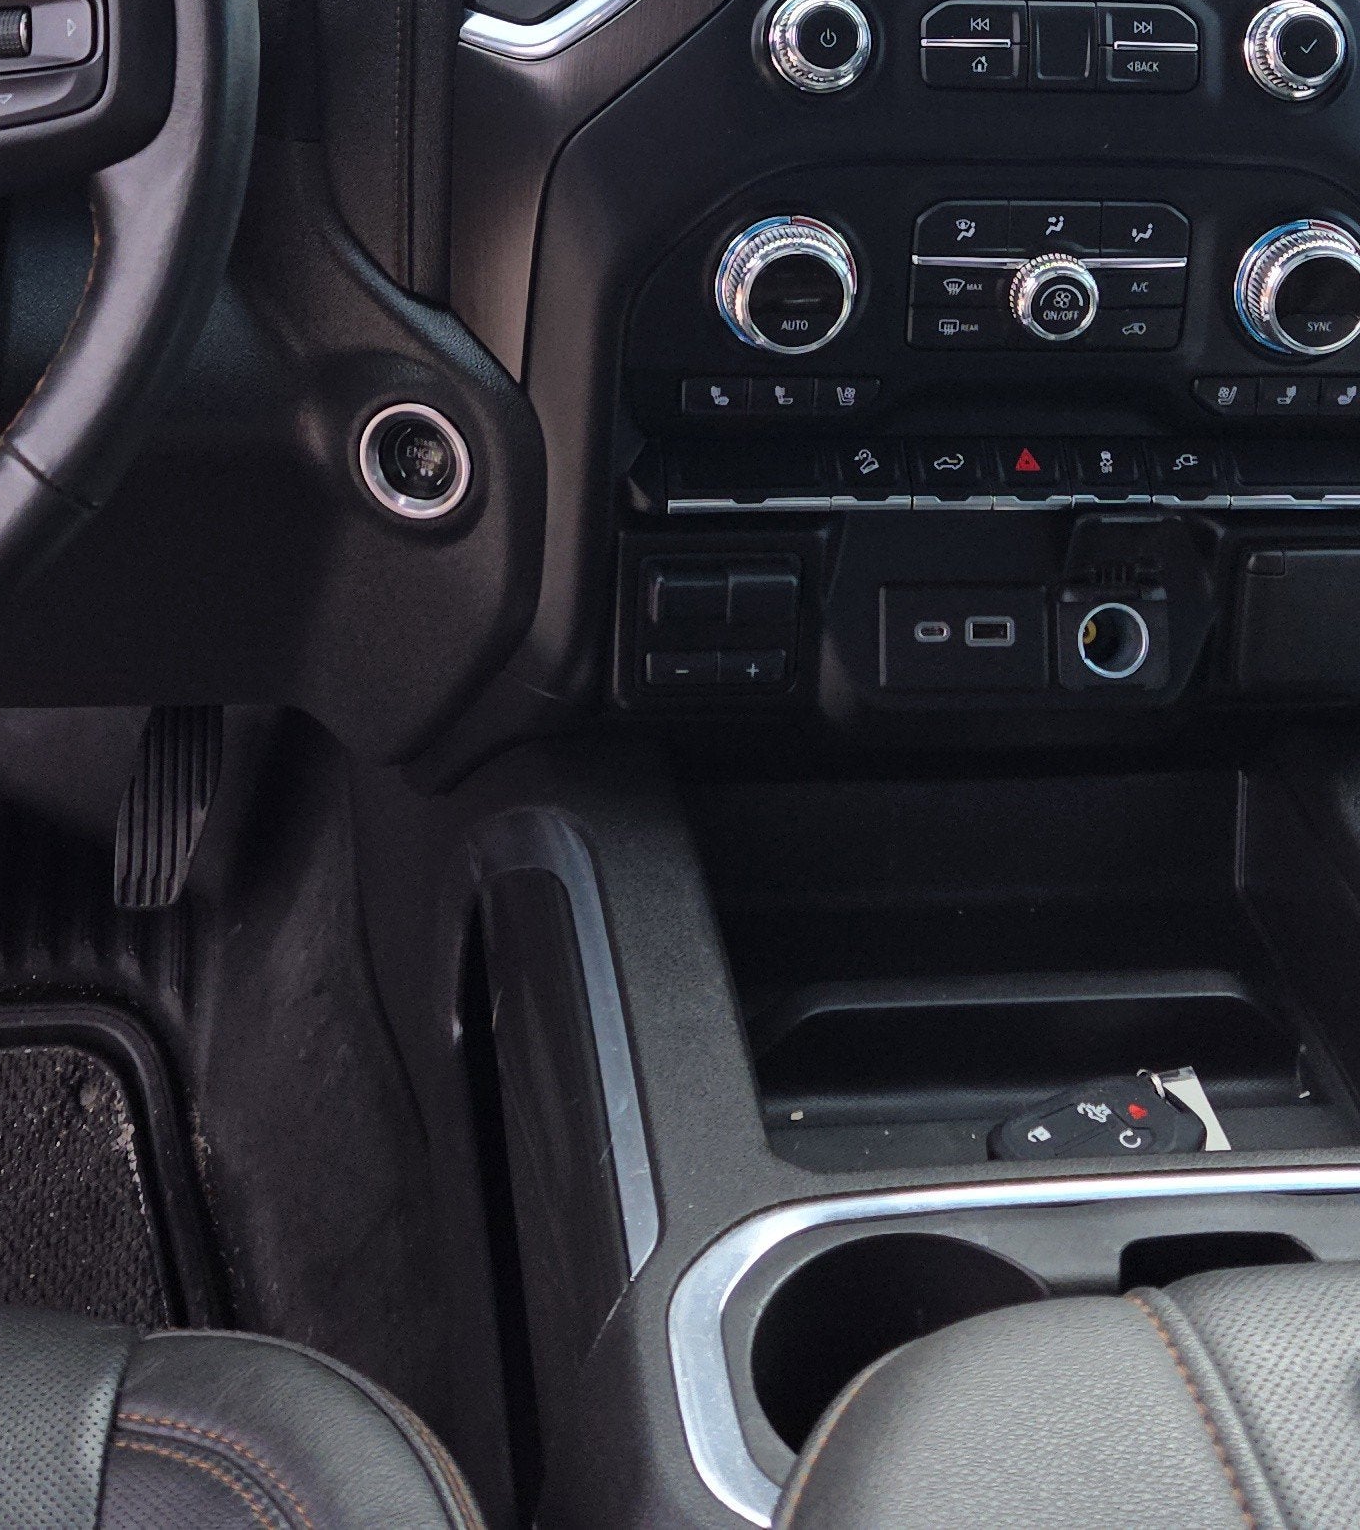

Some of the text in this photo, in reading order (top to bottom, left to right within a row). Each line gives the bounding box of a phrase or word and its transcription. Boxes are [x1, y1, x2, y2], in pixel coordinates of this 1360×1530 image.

[1134, 60, 1160, 72] BACK
[966, 283, 983, 291] MAX
[1131, 281, 1149, 293] A/C
[1042, 310, 1080, 321] ON/OFF
[780, 319, 809, 332] AUTO
[1307, 321, 1333, 332] SYNC
